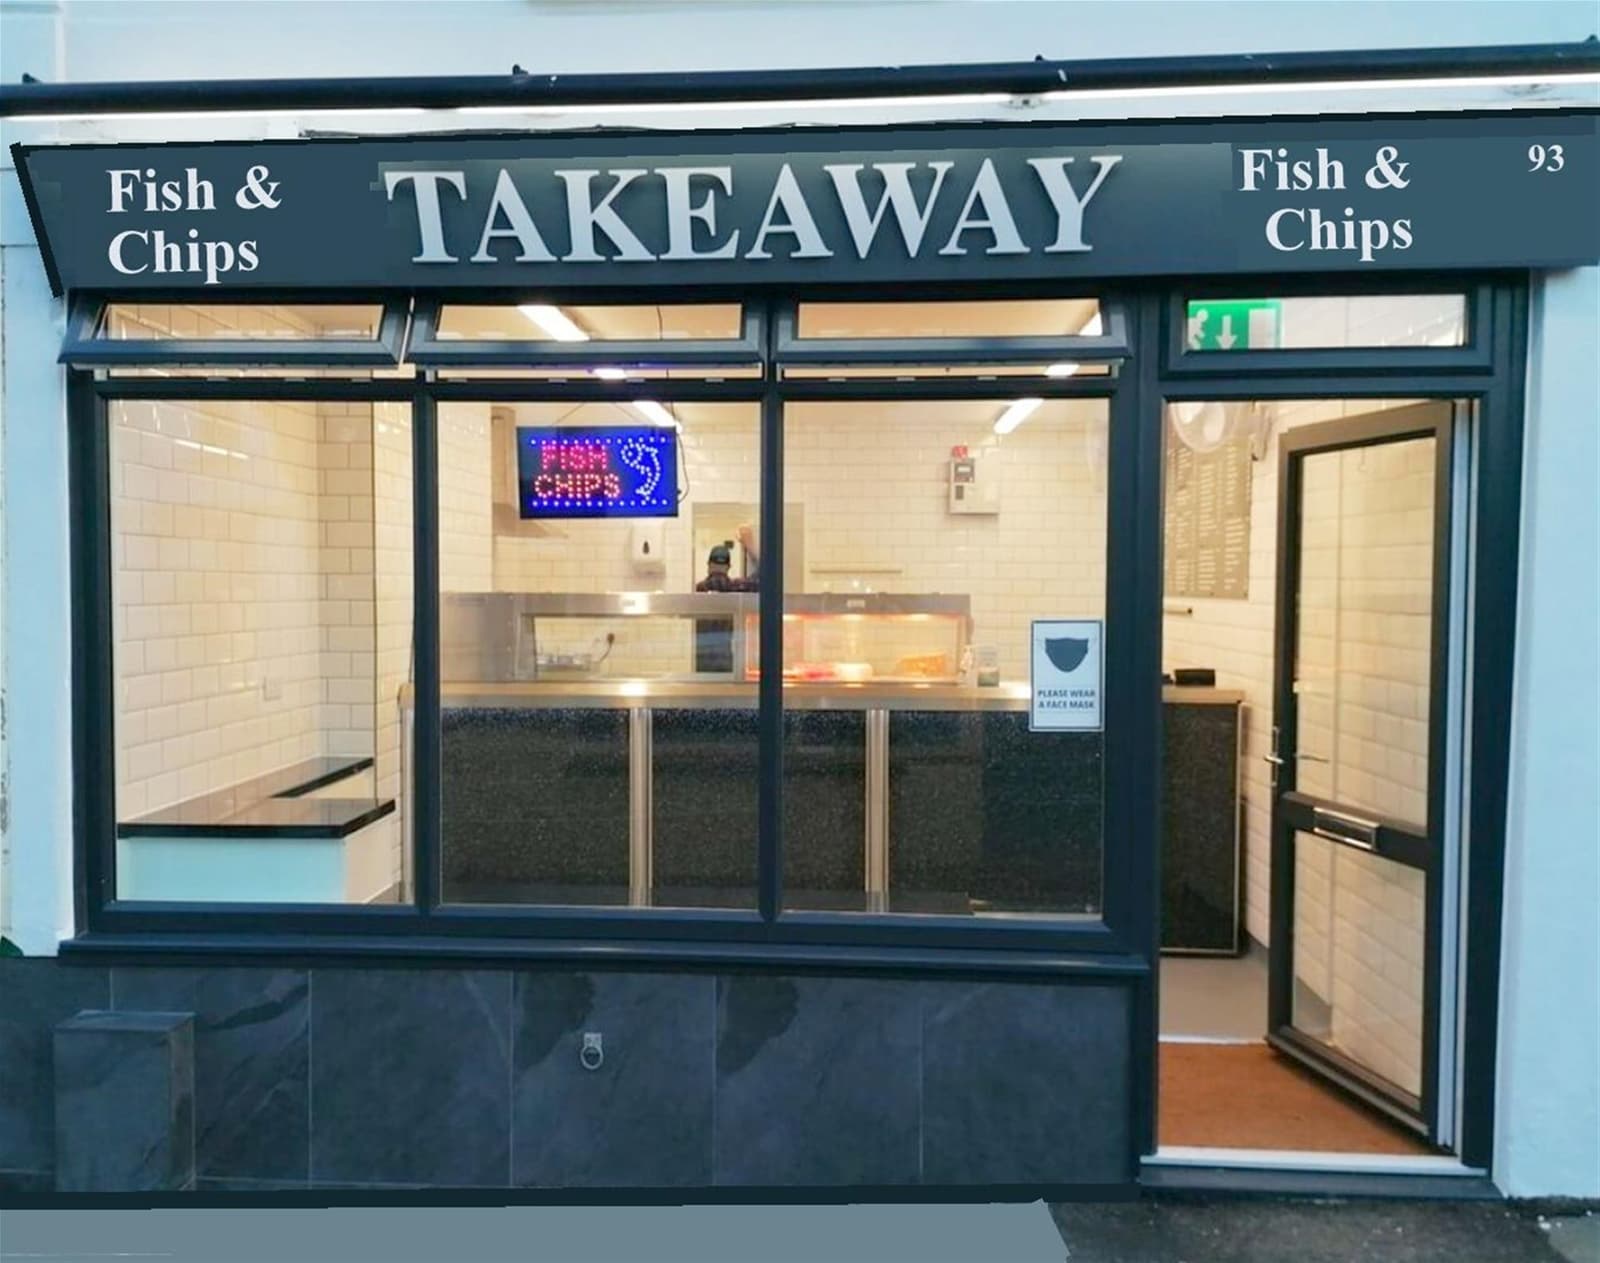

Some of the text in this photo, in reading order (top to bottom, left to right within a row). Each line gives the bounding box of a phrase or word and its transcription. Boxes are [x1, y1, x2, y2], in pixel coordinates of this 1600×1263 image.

[1239, 146, 1411, 192] Fish &
[1527, 144, 1565, 172] 93
[107, 165, 282, 213] Fish &
[384, 154, 1124, 264] TAKEAWAY
[1265, 206, 1414, 263] Chips
[107, 228, 260, 285] Chips
[542, 444, 607, 470] FISH
[534, 473, 621, 499] CHIPS
[1038, 689, 1096, 698] PLEASE WEAR
[1047, 700, 1068, 709] FACE
[1069, 700, 1095, 709] MASK
